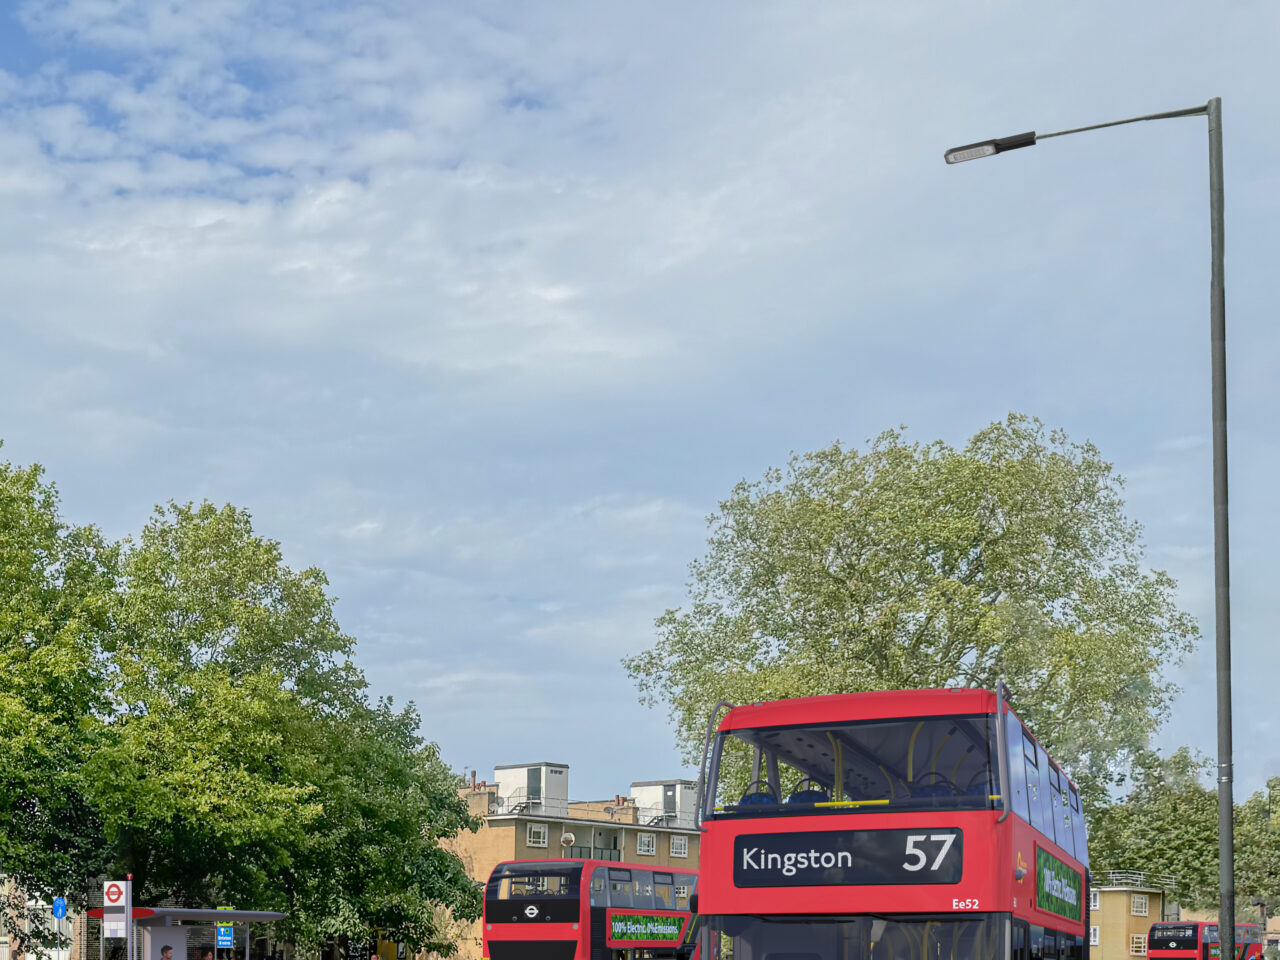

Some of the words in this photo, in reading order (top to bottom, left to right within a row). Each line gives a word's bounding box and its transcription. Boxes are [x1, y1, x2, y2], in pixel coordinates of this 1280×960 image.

[743, 847, 852, 876] Kingston
[902, 834, 957, 872] 57
[952, 898, 980, 910] Ee52
